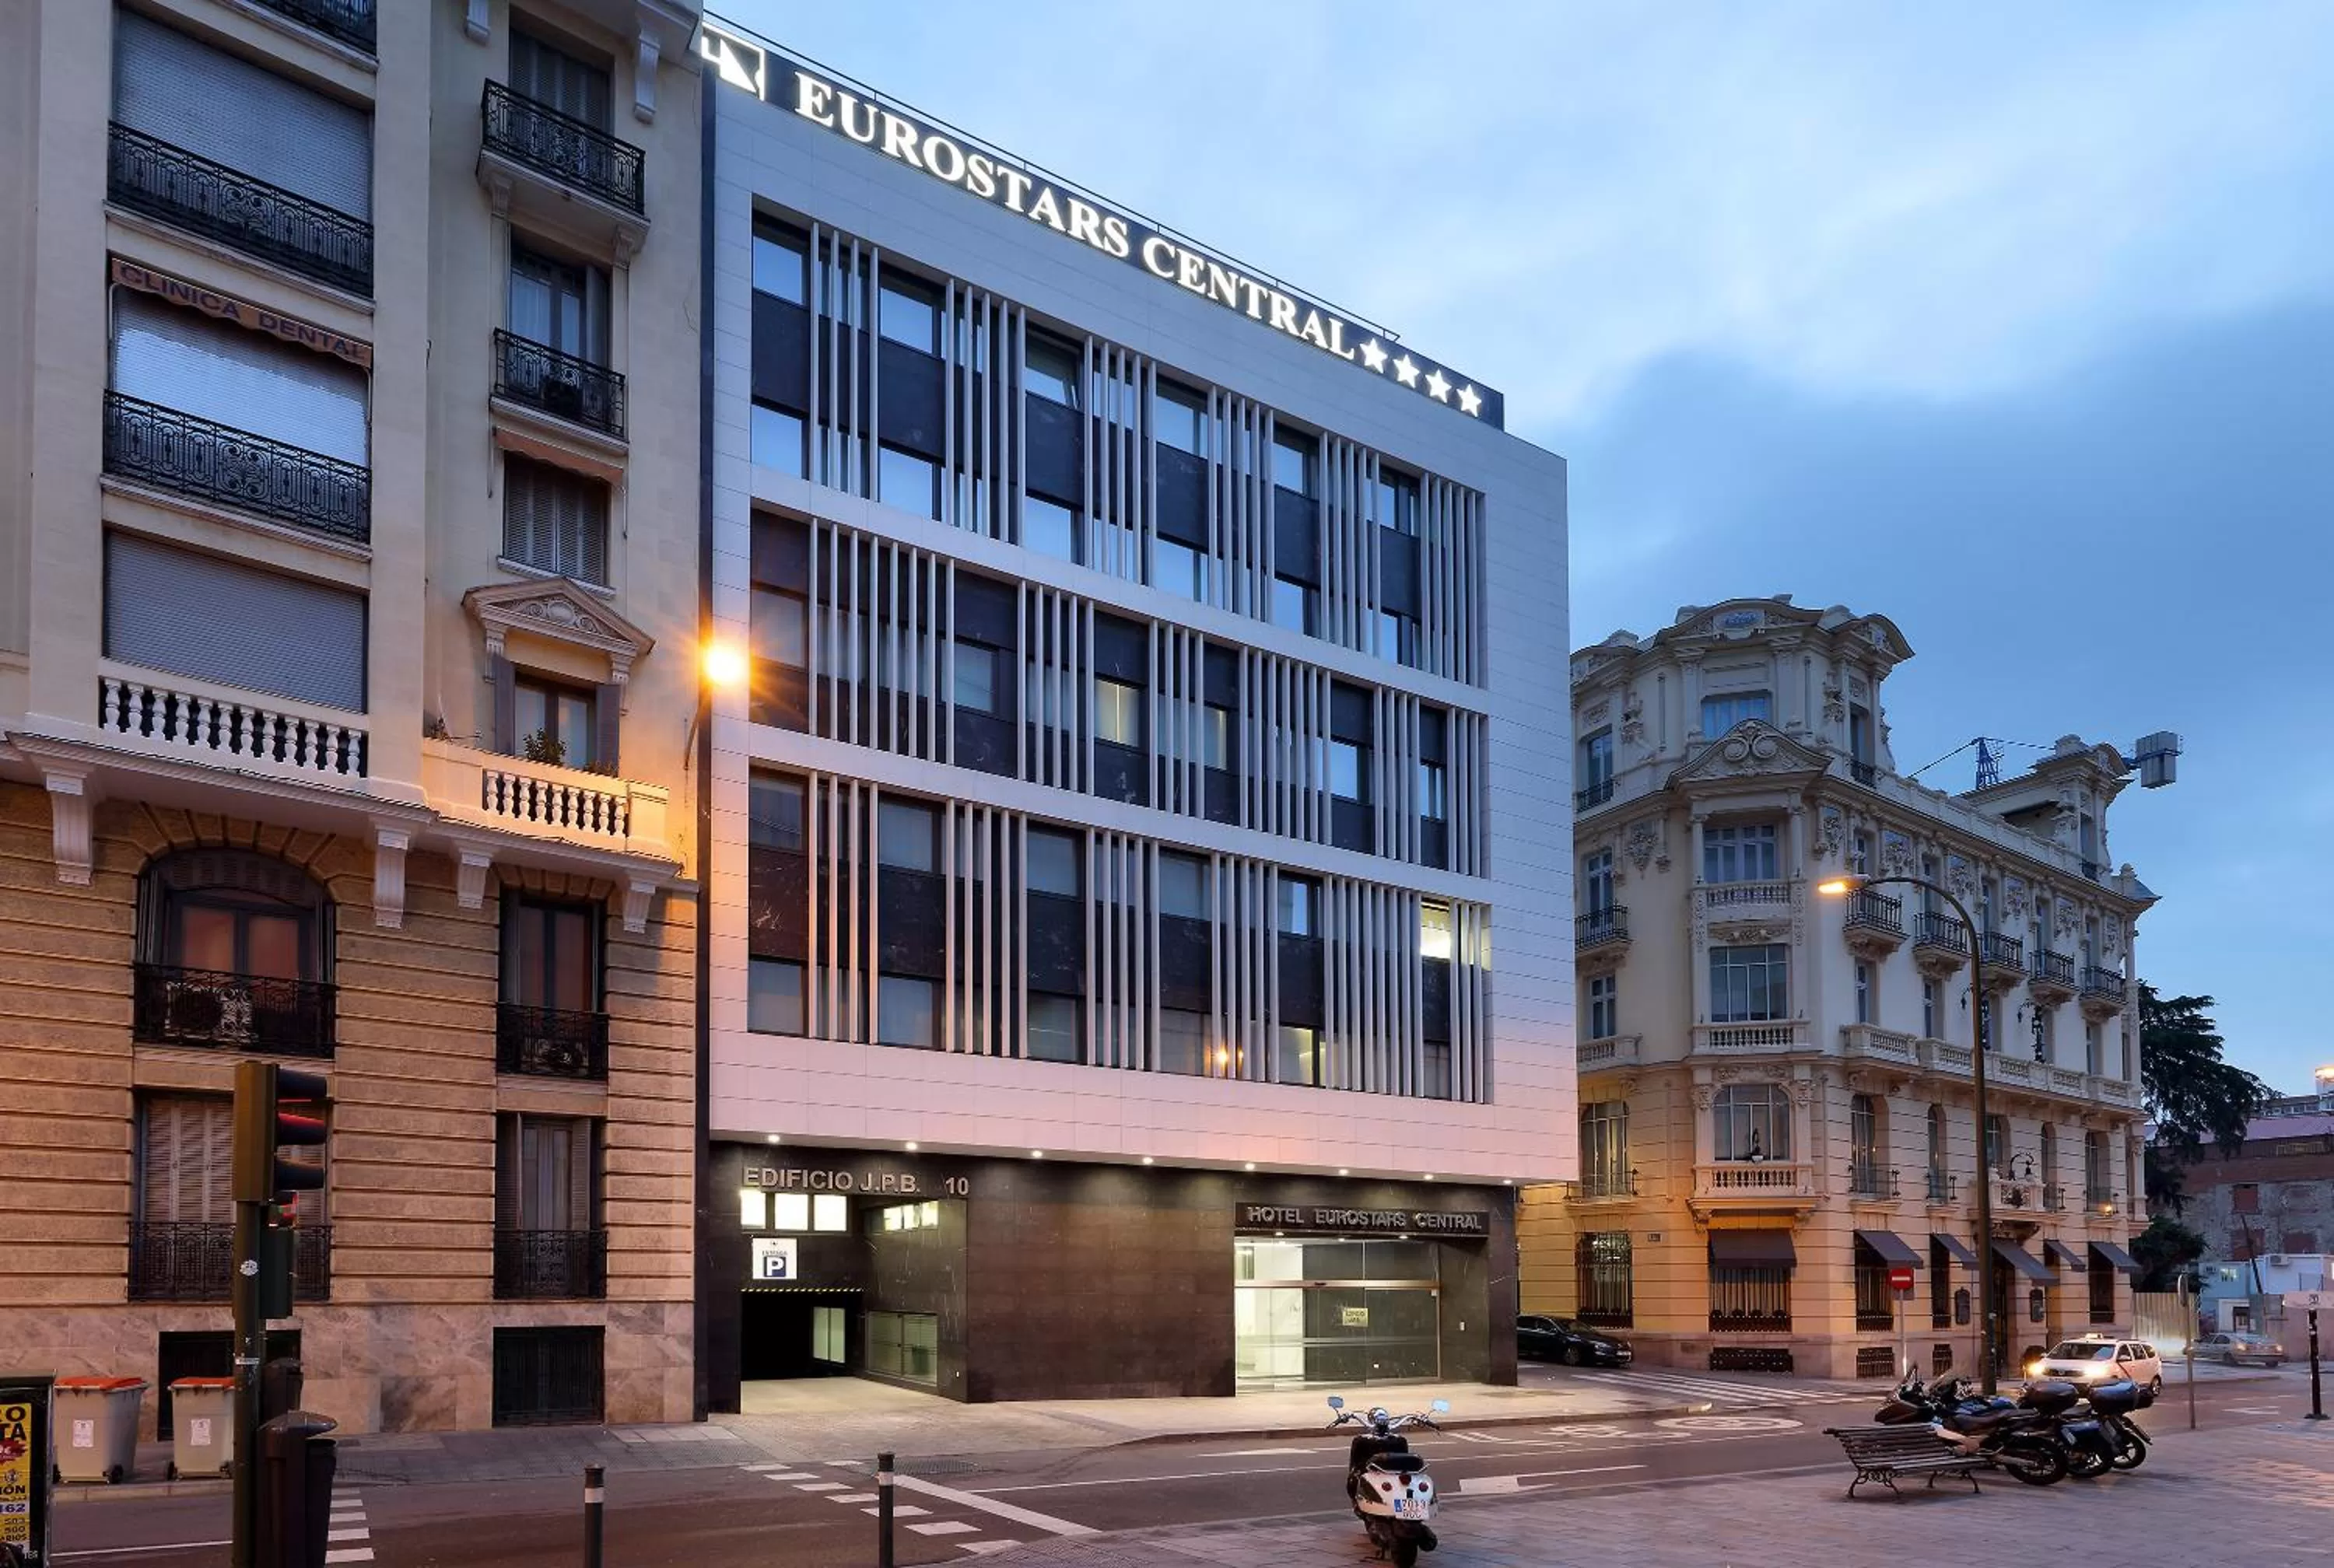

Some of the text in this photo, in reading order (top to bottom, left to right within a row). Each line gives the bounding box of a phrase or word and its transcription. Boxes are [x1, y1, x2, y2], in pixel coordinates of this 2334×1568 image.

[794, 71, 1354, 360] EUROSTARS CENTRAL
[121, 265, 365, 360] CLINICA DENTAL
[742, 1167, 969, 1195] EDIFICIO J.P.B. 10
[1246, 1206, 1482, 1230] HOTEL EUROSTARS CENTRAL
[766, 1257, 783, 1276] P
